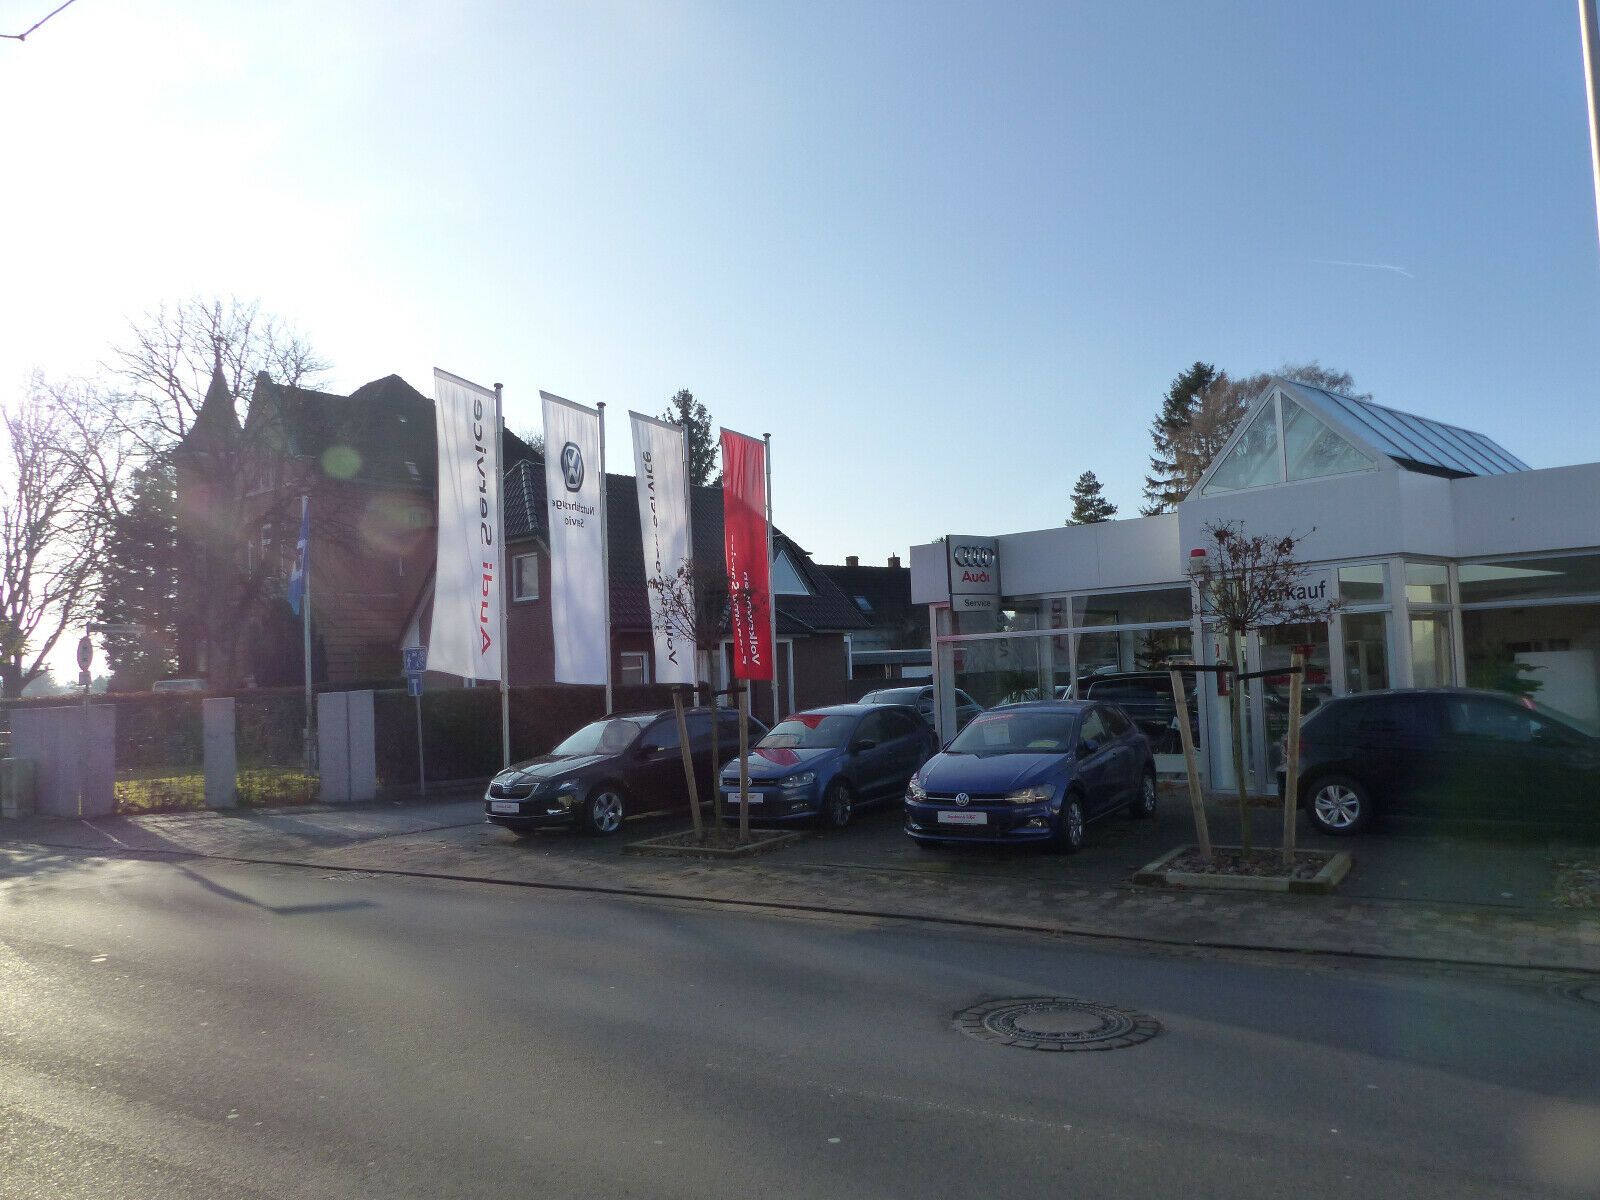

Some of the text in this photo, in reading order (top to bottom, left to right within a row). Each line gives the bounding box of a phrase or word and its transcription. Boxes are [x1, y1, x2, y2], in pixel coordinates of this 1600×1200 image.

[962, 570, 991, 583] Audi
[1256, 580, 1326, 601] erkauf
[964, 599, 991, 607] Service
